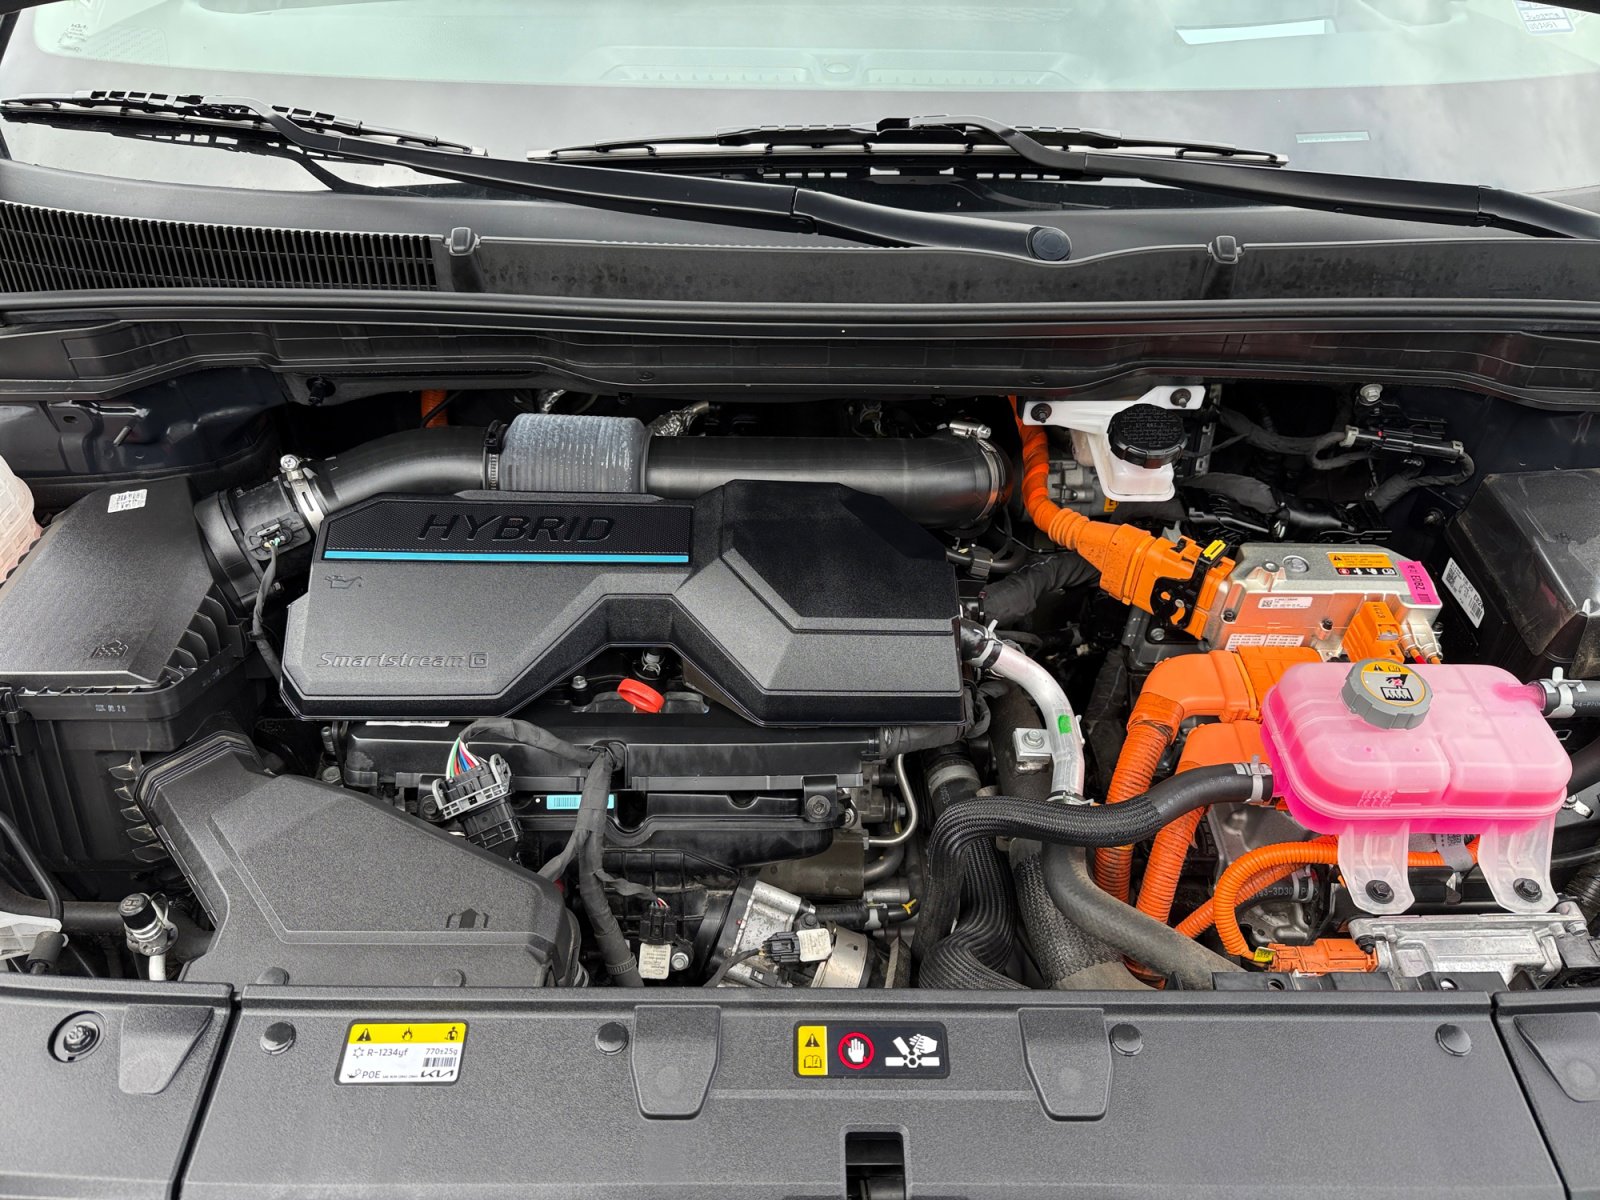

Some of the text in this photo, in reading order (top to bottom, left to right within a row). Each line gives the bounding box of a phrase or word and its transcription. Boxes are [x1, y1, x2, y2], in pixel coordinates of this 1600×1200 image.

[417, 514, 614, 542] HYBRID
[317, 652, 465, 667] Smartstream
[367, 1047, 458, 1057] R-1234yf 770±25g
[362, 1070, 381, 1079] POE
